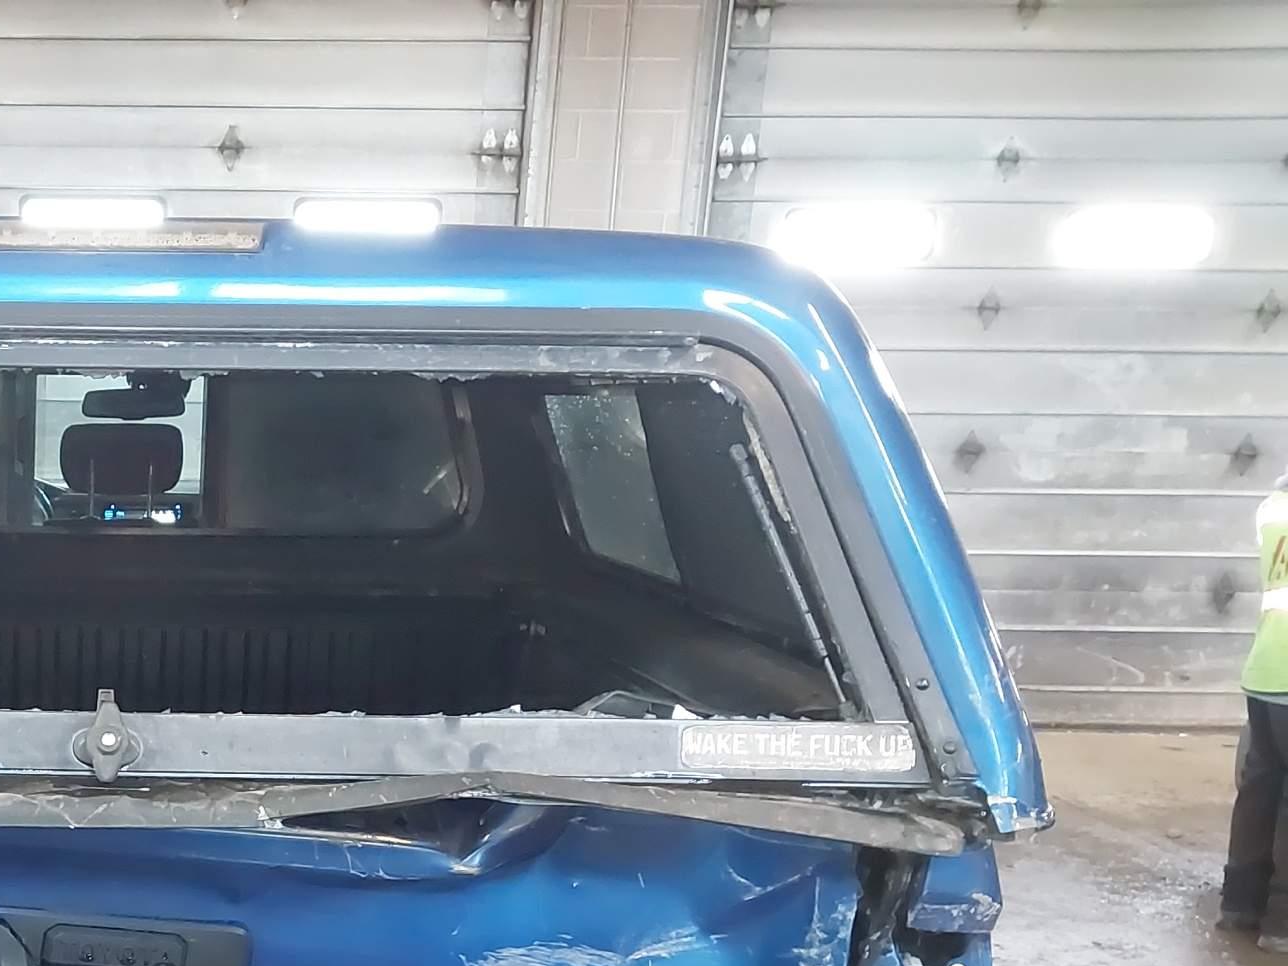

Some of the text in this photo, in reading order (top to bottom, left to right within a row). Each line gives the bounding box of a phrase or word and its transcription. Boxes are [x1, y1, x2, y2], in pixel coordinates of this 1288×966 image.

[685, 732, 749, 755] WAKE
[753, 733, 802, 757] THE
[809, 734, 873, 758] FUCK
